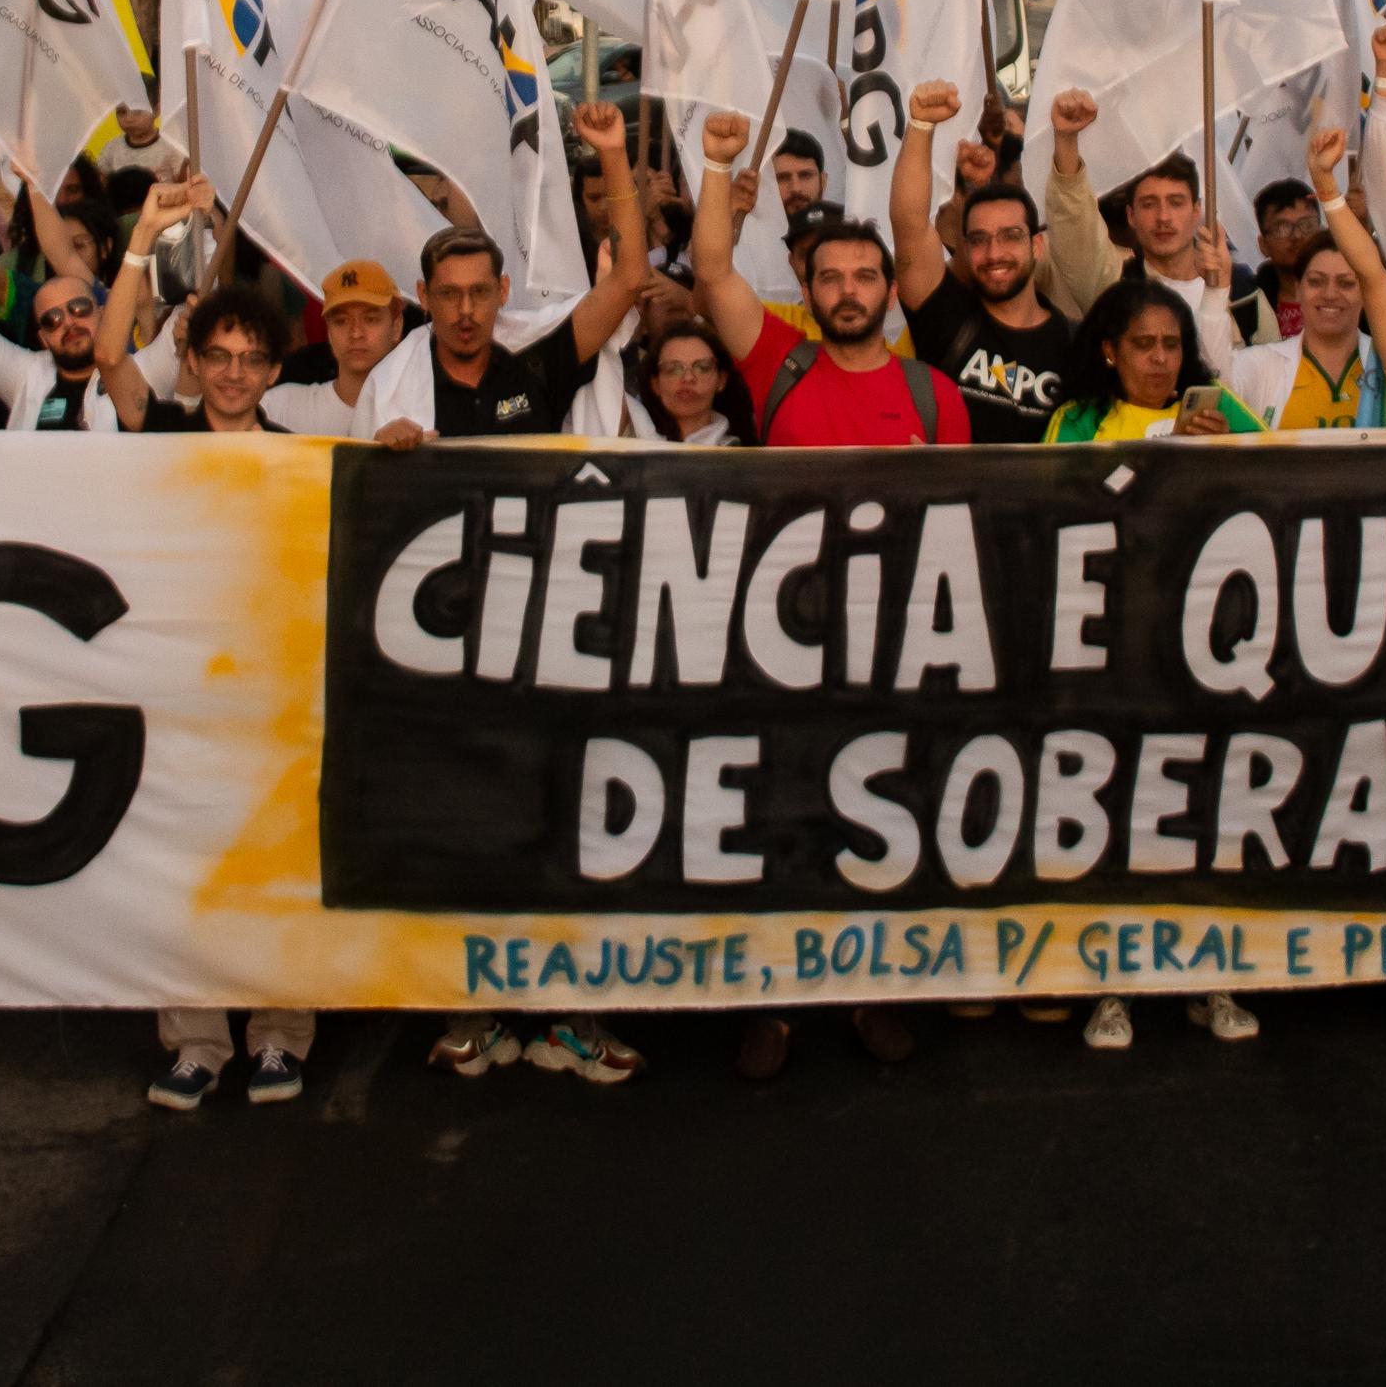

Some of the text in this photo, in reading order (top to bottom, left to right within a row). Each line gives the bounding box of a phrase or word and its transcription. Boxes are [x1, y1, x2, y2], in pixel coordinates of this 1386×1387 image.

[412, 14, 490, 76] ASSOCIAÇÃO
[1050, 464, 1136, 672] É
[579, 736, 764, 884] DE
[465, 932, 773, 993] REAJUSTE,
[796, 919, 964, 980] BOLSA
[1077, 919, 1256, 982] GERAL
[1287, 925, 1313, 975] E
